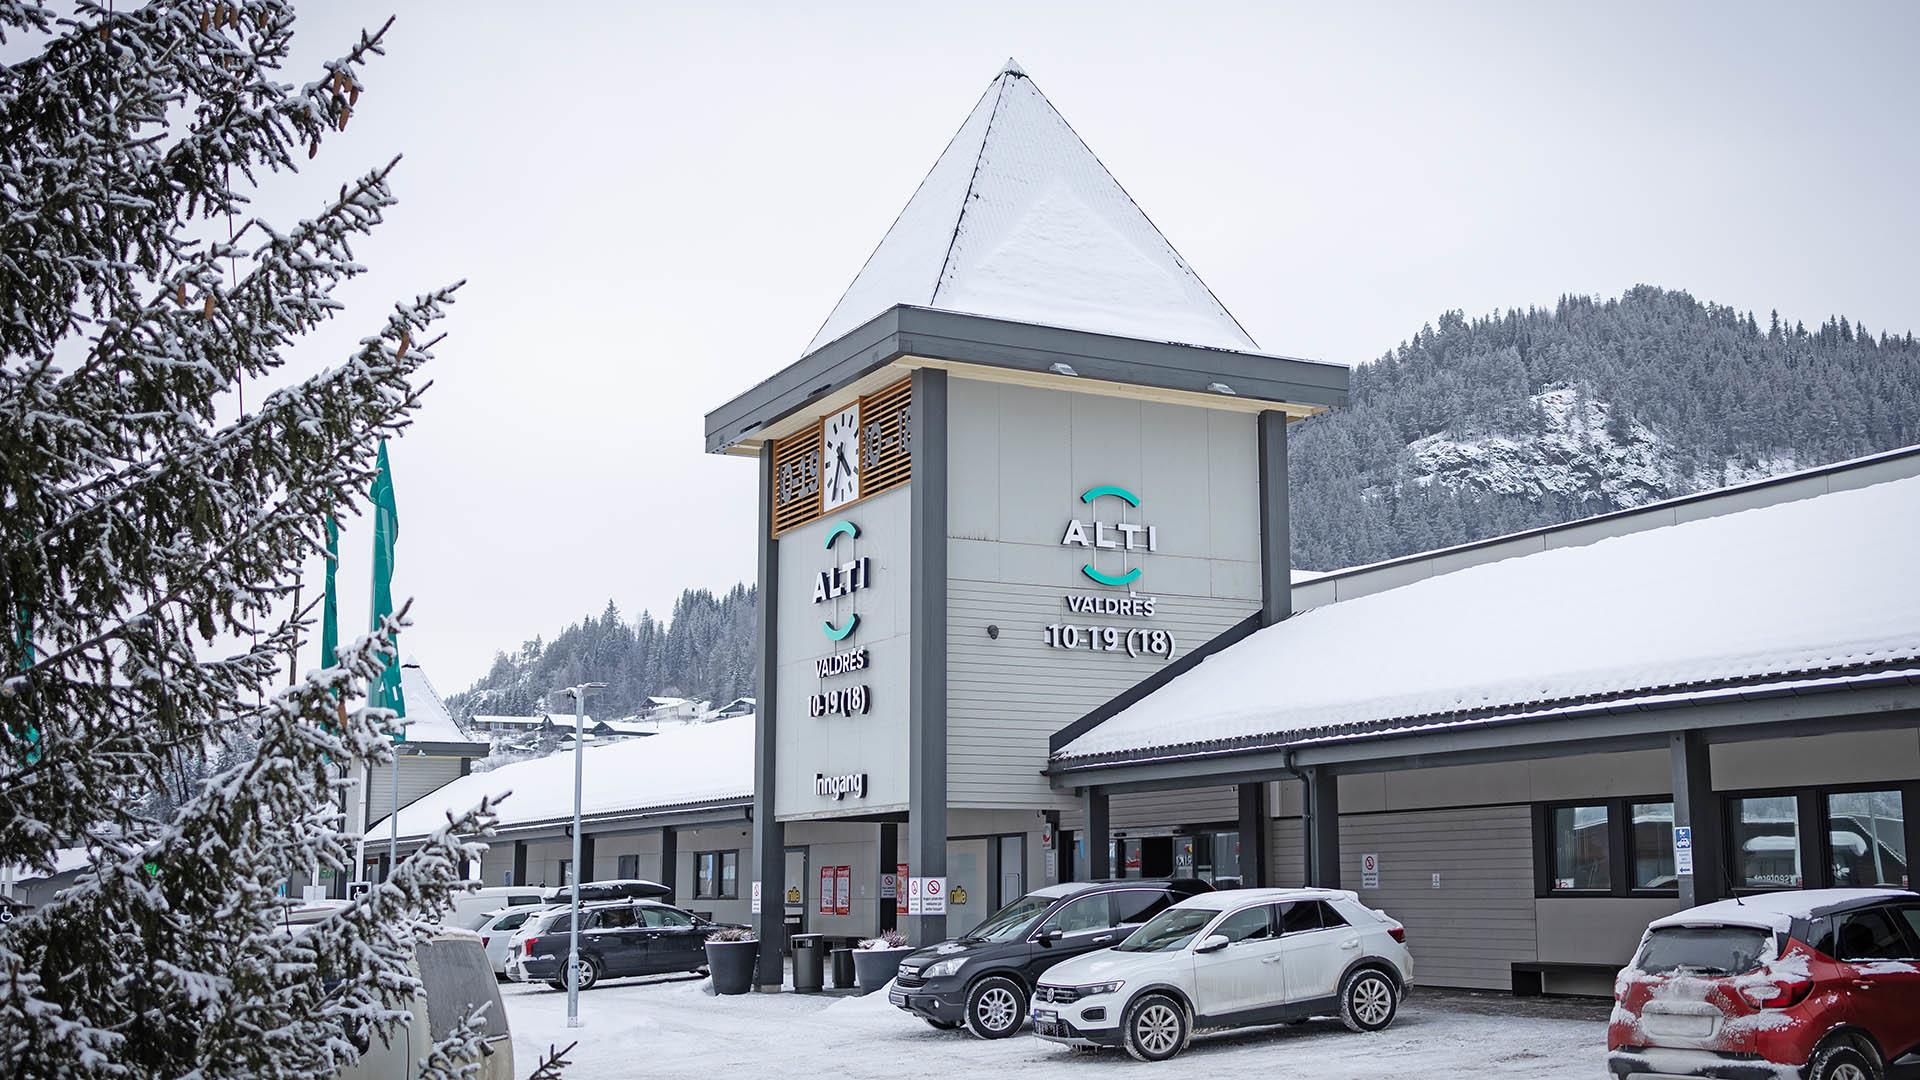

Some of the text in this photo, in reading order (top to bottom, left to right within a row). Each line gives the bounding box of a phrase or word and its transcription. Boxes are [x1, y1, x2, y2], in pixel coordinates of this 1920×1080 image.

[1062, 519, 1157, 551] ALTI
[812, 556, 869, 604] ALTI
[1066, 594, 1157, 617] VALDRES
[1049, 623, 1176, 660] 10-19 (18)
[815, 646, 868, 678] VALDRES
[808, 684, 869, 717] 10-19 (18)
[813, 772, 867, 801] Inngang
